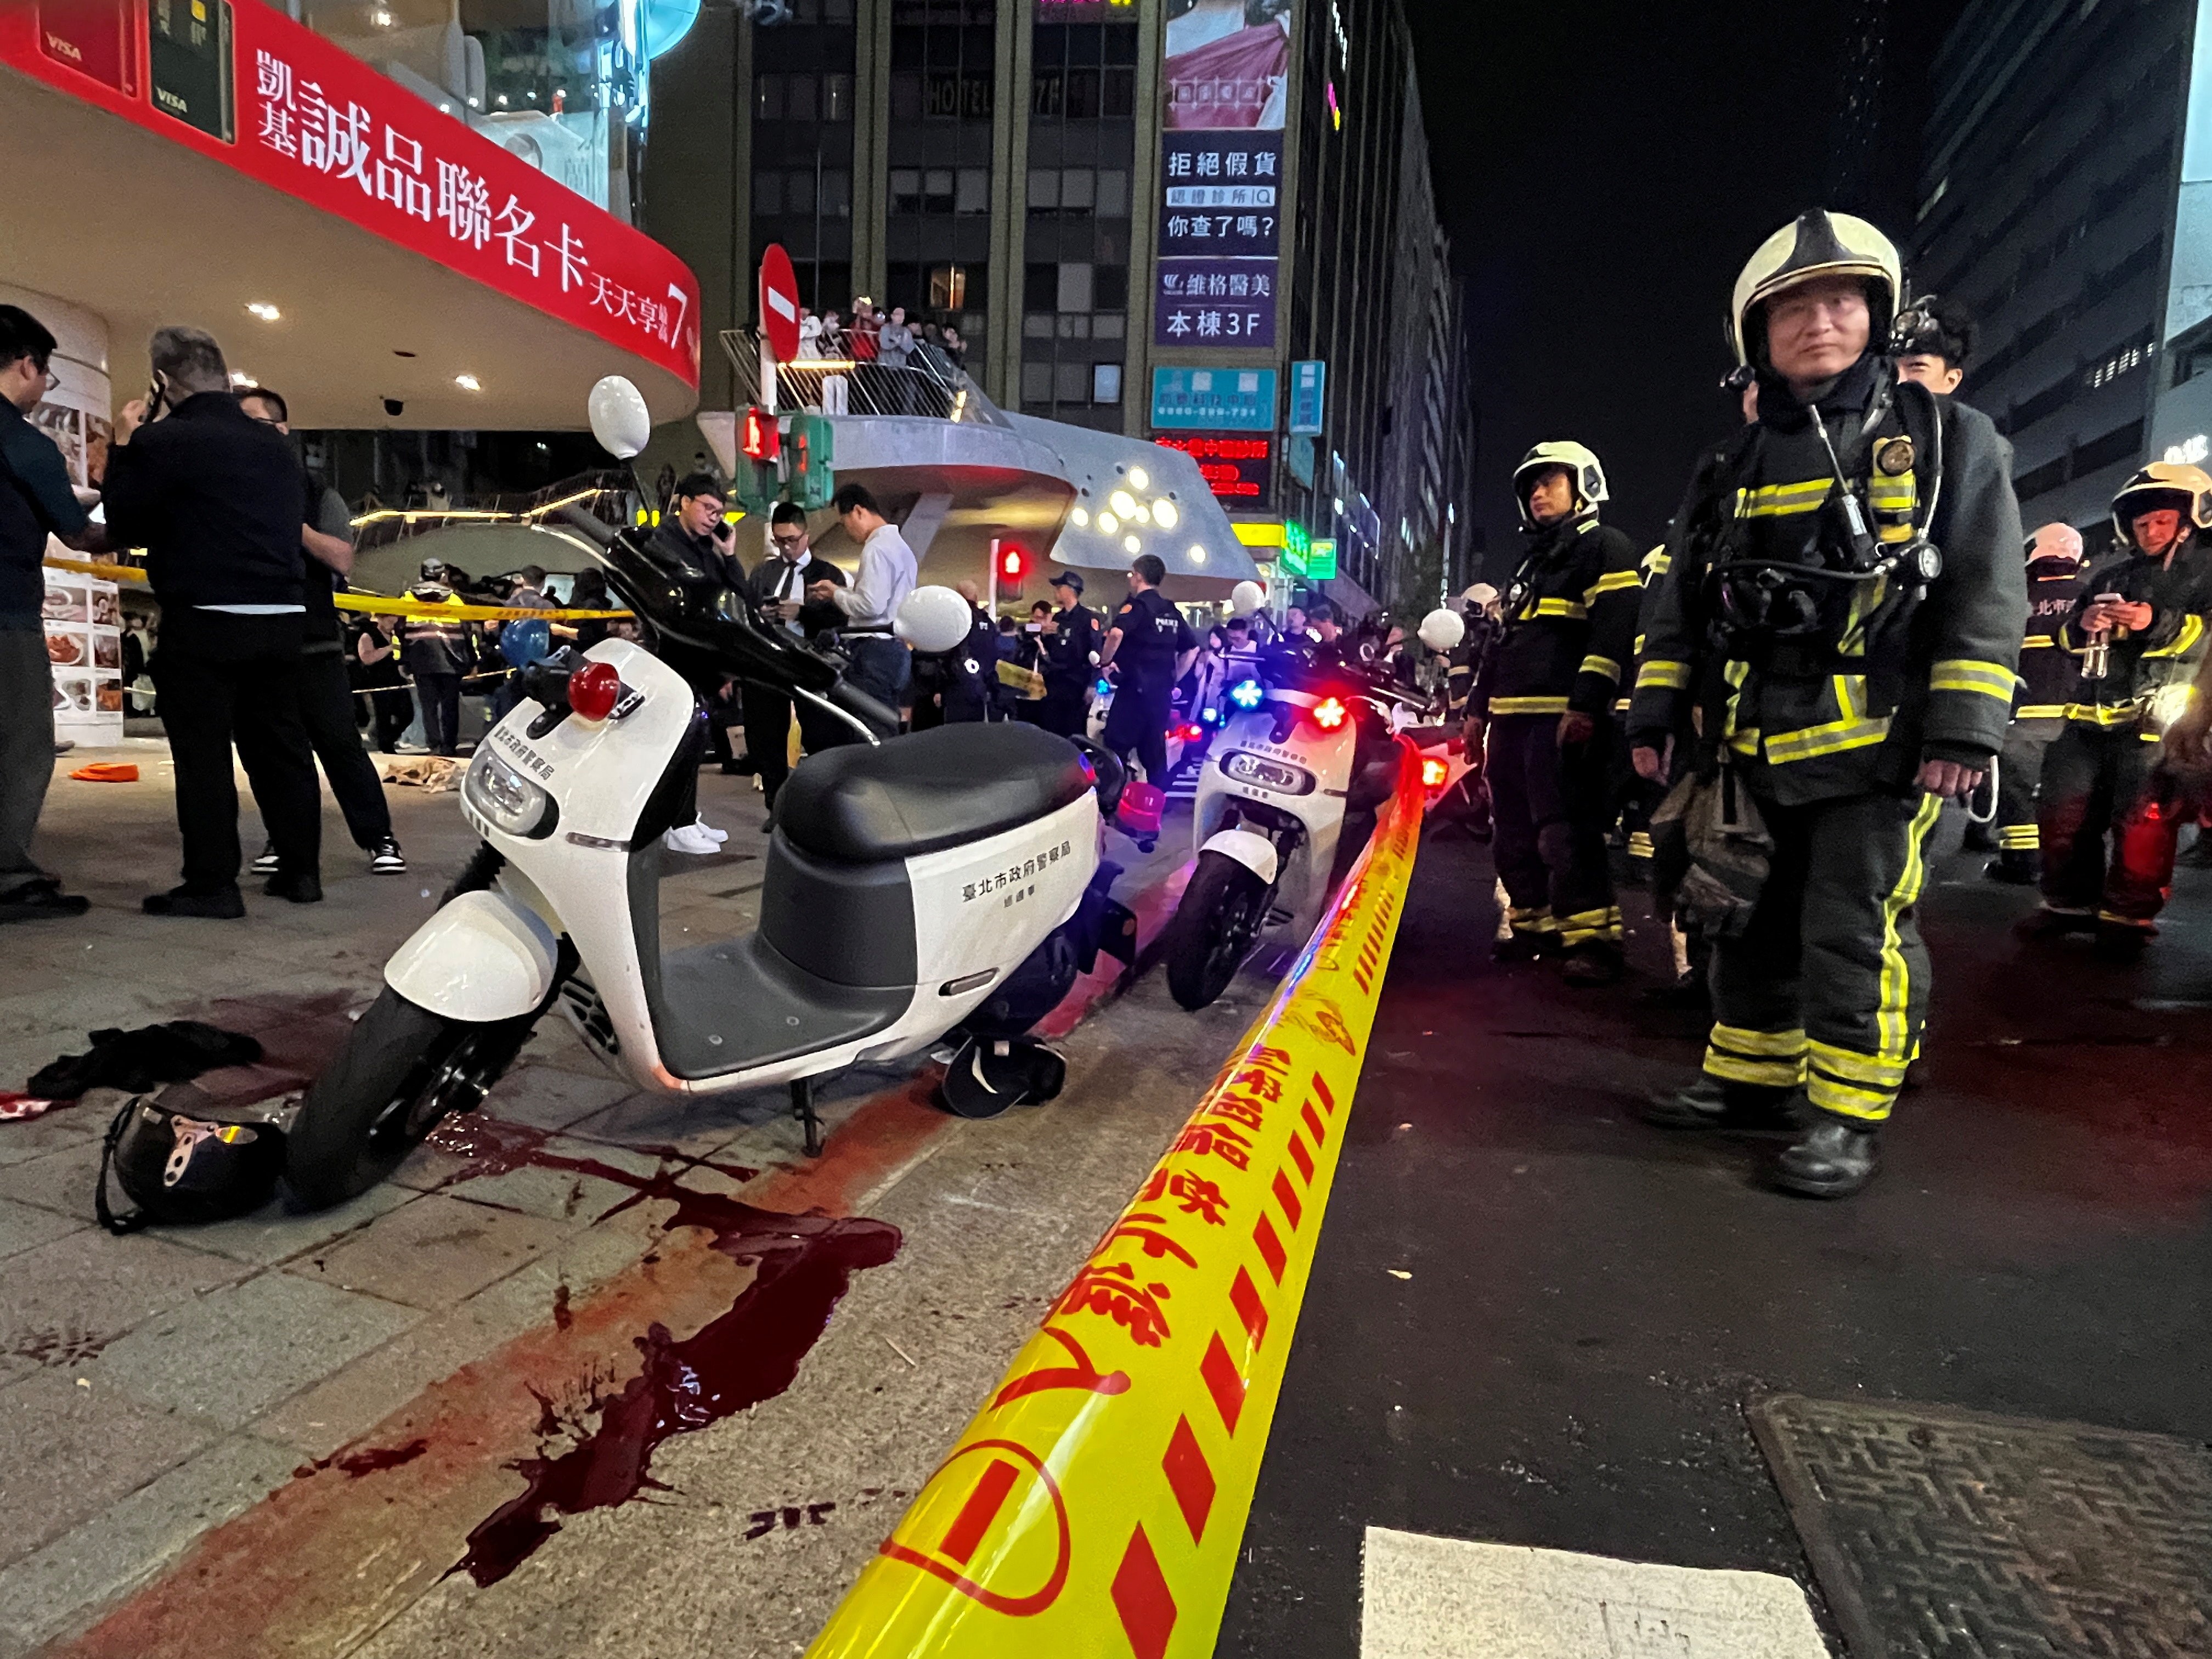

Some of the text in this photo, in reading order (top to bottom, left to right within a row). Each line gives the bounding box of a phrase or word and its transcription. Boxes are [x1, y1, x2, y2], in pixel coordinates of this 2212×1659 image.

[46, 31, 82, 61] VISA
[154, 83, 188, 114] VISA
[256, 49, 297, 159] 凱基
[1168, 152, 1276, 176] 拒絕假貨
[300, 80, 589, 292] 誠品聯名卡
[1186, 274, 1271, 297] 維格醫美
[589, 272, 658, 334] 天天享
[1167, 309, 1261, 338] 本棟3F
